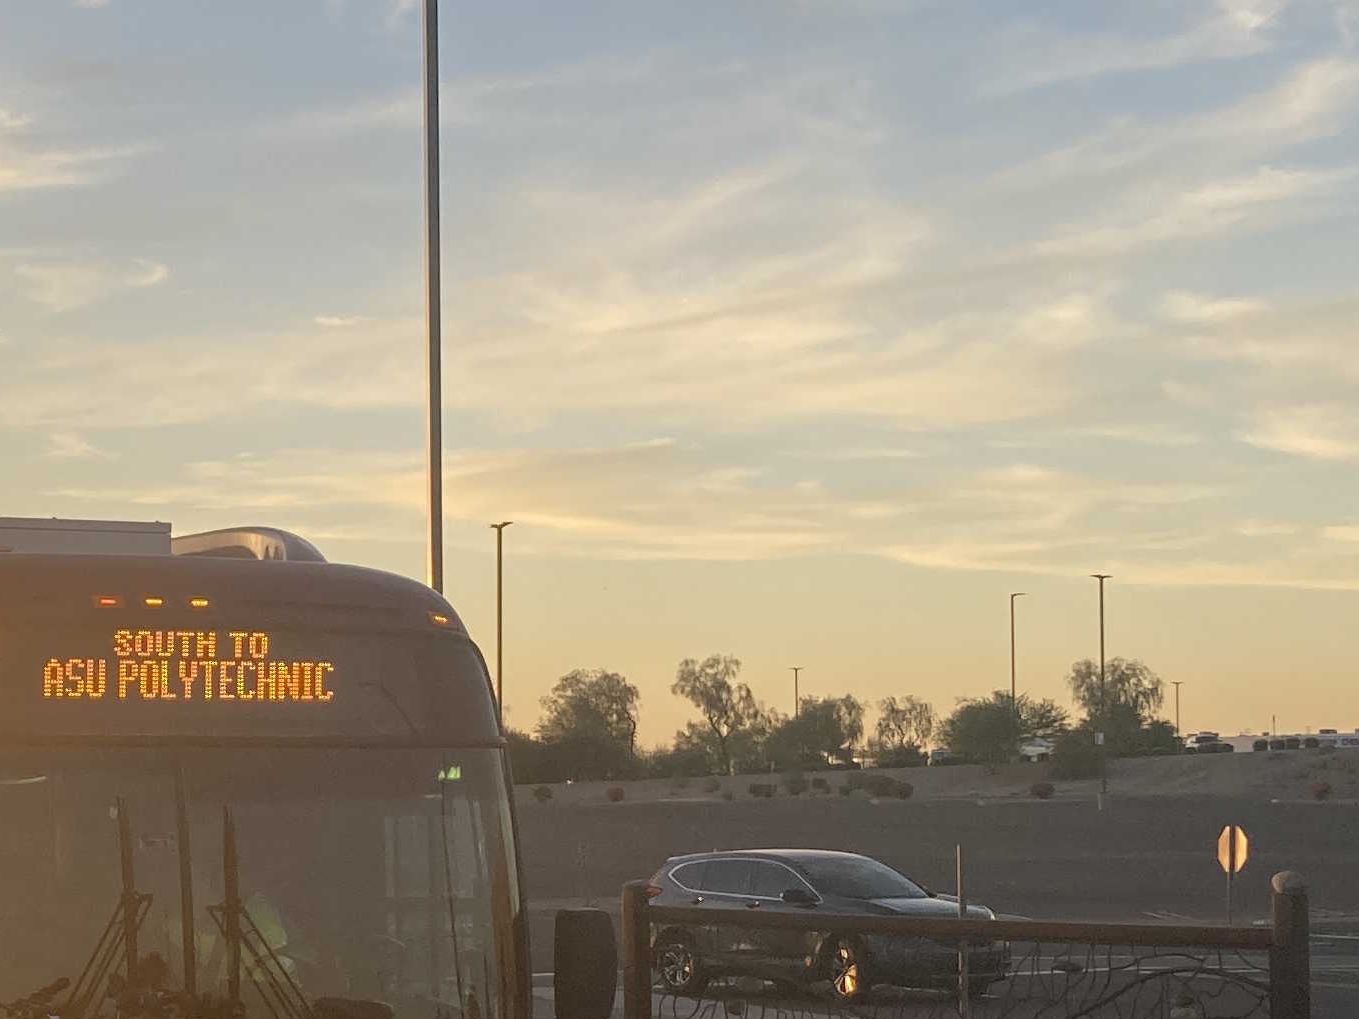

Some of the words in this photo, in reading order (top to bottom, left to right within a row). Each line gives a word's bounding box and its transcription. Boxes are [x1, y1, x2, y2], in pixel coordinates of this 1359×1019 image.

[113, 629, 217, 657] SOUTH
[229, 631, 270, 659] TO
[43, 658, 107, 697] ASU
[117, 659, 335, 700] POLYTECHNIC
